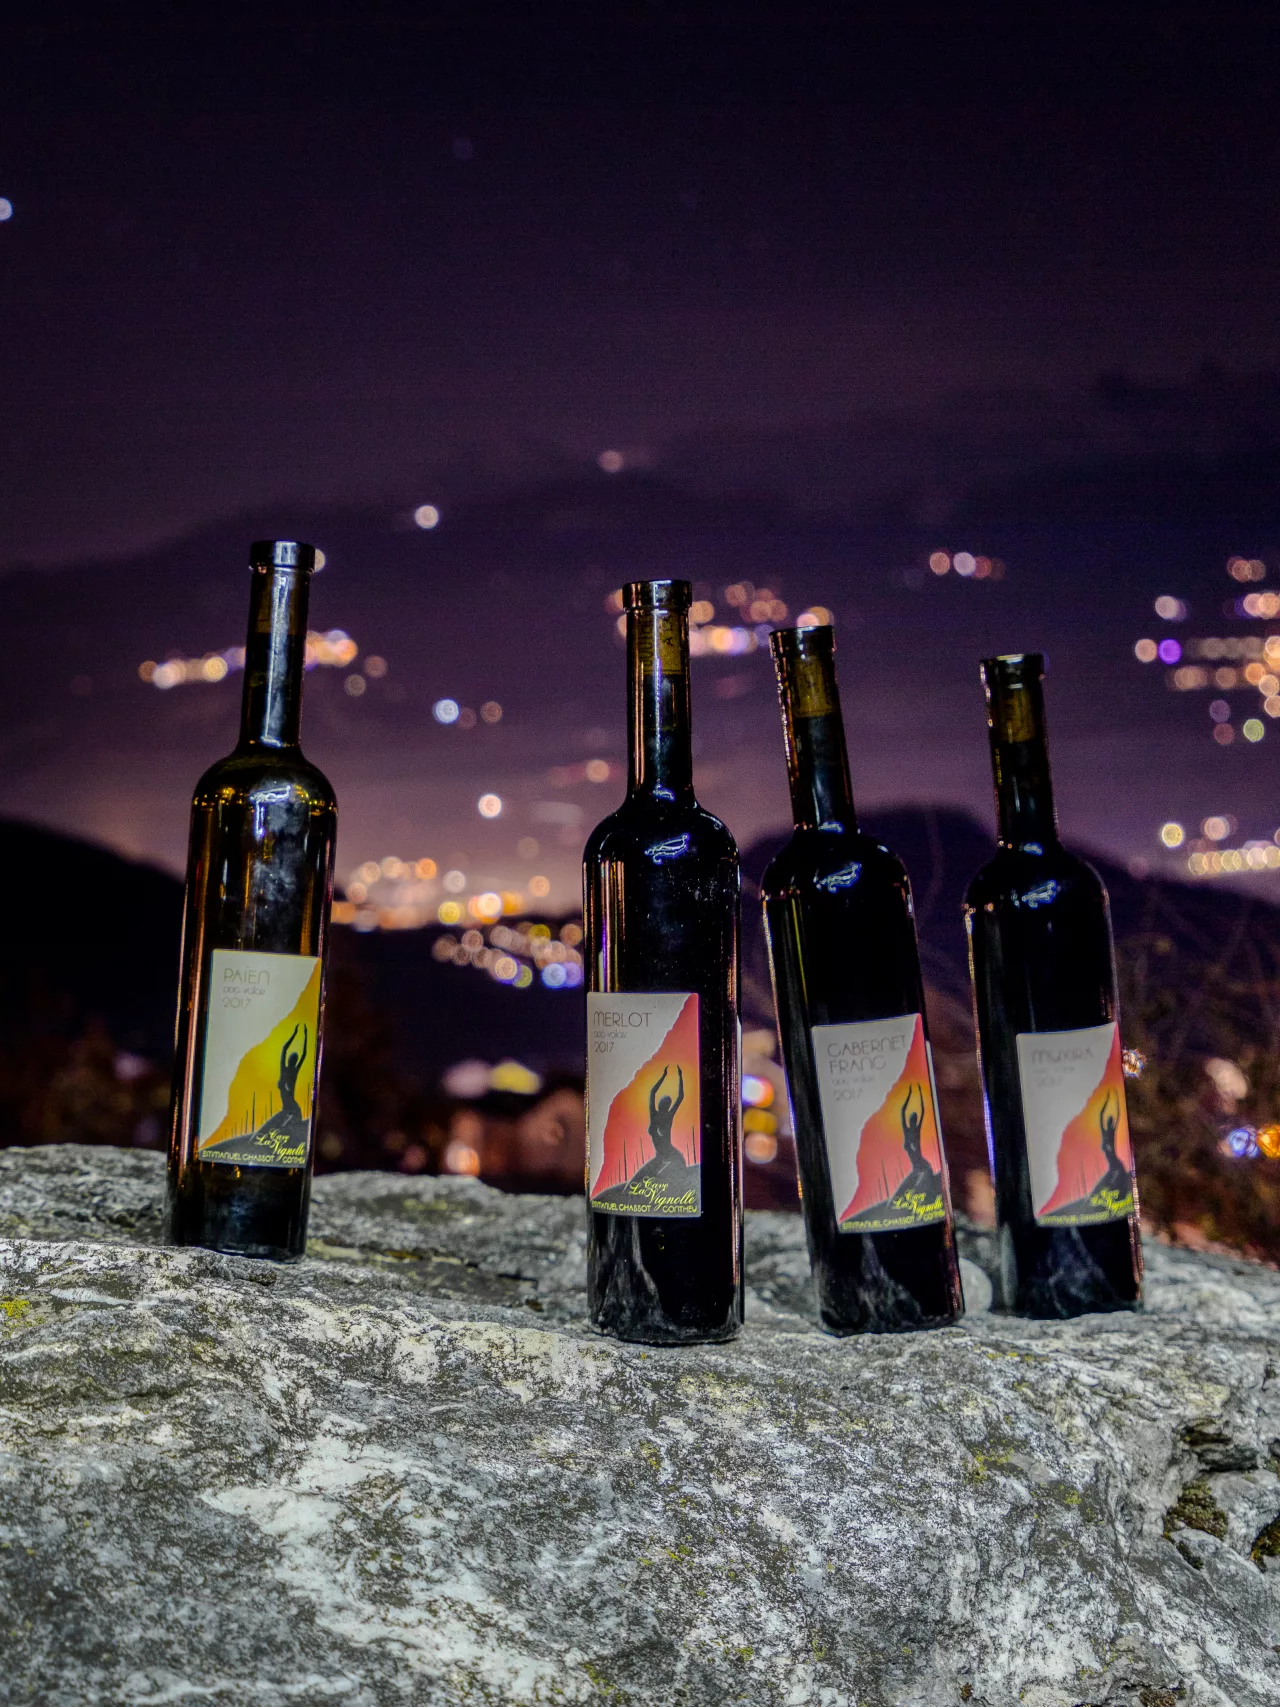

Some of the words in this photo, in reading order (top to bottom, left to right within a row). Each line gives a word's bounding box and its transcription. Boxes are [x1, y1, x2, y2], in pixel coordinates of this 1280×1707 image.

[221, 997, 252, 1010] 2017
[593, 1011, 652, 1028] MERLOT
[593, 1041, 615, 1053] 2017
[827, 1034, 907, 1058] CABERNET
[828, 1055, 886, 1075] FRANC
[629, 1182, 646, 1195] La
[643, 1176, 668, 1190] Cave
[619, 1204, 651, 1213] CHASSOT
